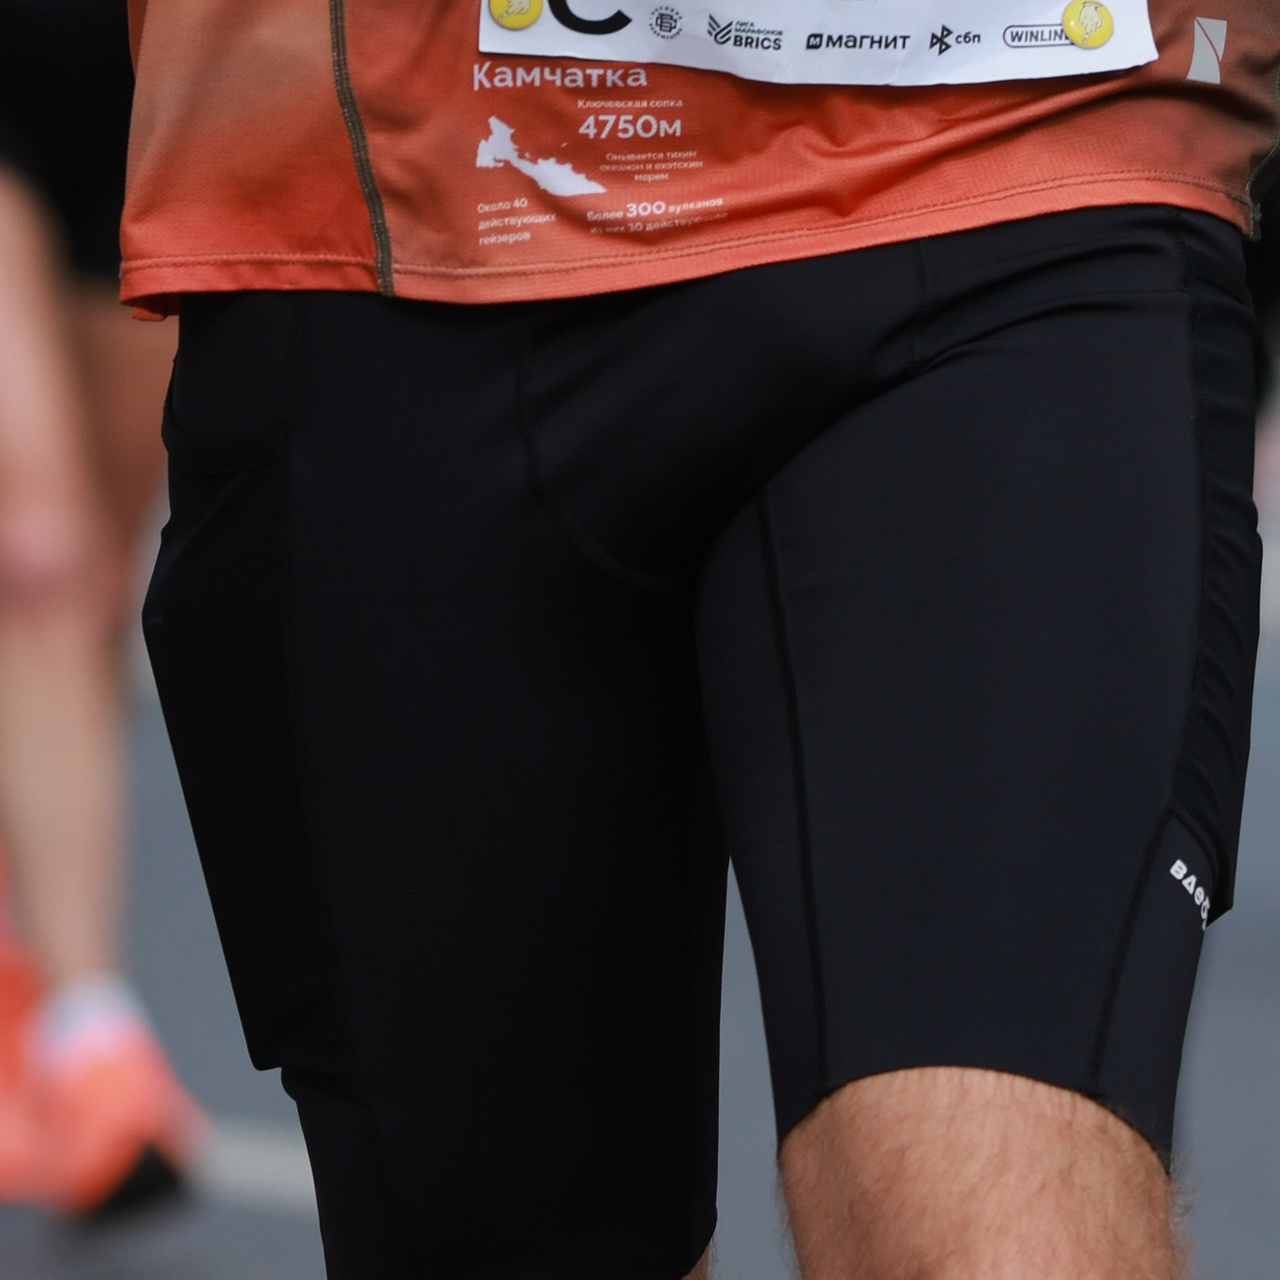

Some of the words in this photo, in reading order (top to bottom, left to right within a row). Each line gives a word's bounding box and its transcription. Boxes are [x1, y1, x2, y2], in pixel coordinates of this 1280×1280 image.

[733, 35, 782, 51] BRICS
[826, 32, 911, 50] магнит
[955, 32, 981, 46] сбп
[1010, 28, 1070, 43] WINLIN
[473, 61, 647, 91] Камчатка
[577, 99, 648, 109] Ключевская
[650, 100, 683, 108] сопка
[578, 114, 683, 140] 4750м
[512, 197, 529, 209] 40
[626, 200, 667, 218] 300
[668, 197, 724, 214] вулканов
